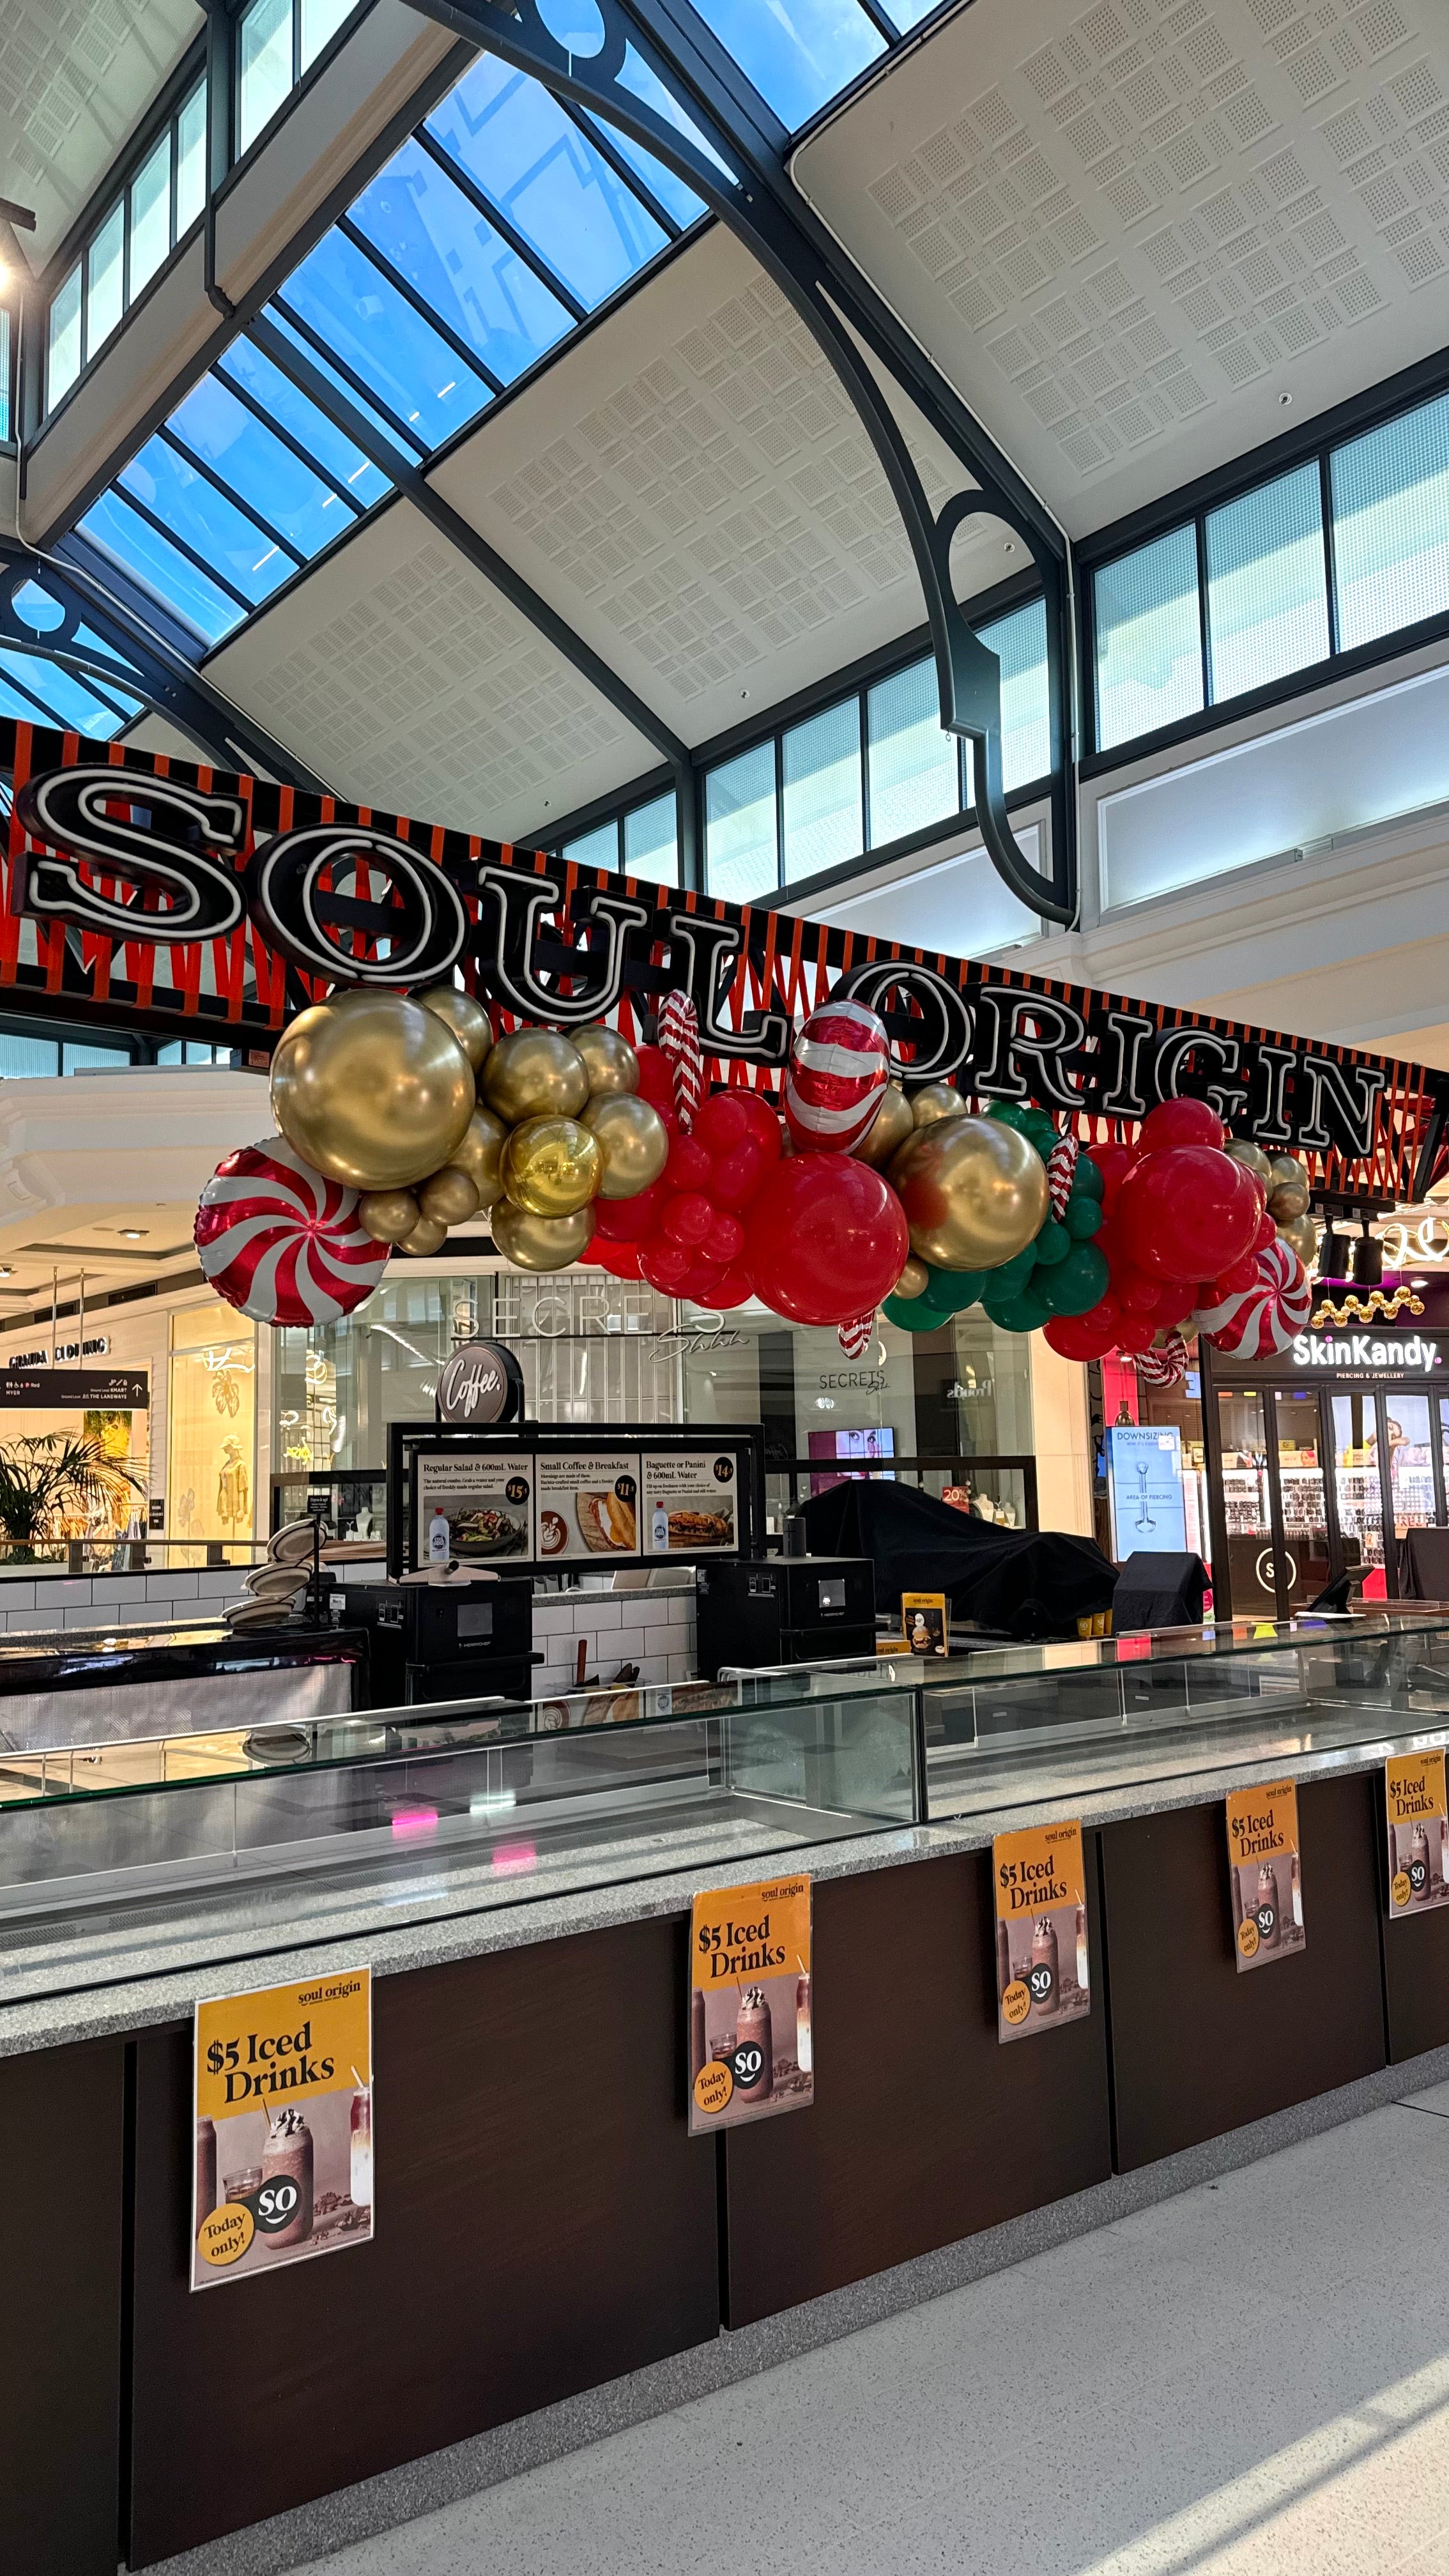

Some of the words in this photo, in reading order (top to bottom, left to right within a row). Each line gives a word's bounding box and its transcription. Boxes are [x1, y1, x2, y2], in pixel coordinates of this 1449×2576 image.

[12, 762, 794, 1068] SOUL
[829, 958, 1388, 1158] ORIGIN
[820, 1370, 884, 1389] SECRETS
[424, 1464, 452, 1474] Regular
[454, 1463, 473, 1471] Salad
[540, 1462, 561, 1470] Small
[646, 1460, 675, 1471] Baguette
[944, 1489, 967, 1501] 20%
[1266, 1788, 1276, 1798] soul
[1276, 1786, 1292, 1797] origin
[1390, 1780, 1401, 1799] $5
[1404, 1775, 1425, 1795] Iced
[1396, 1794, 1434, 1816] Drinks
[1045, 1831, 1057, 1842] soul
[1058, 1827, 1077, 1840] origin
[1232, 1817, 1245, 1839] $5
[1247, 1809, 1274, 1833] Iced
[1240, 1830, 1284, 1857] Drinks
[1000, 1863, 1017, 1889] $5
[1020, 1855, 1055, 1883] Iced
[1411, 1866, 1425, 1881] SO
[762, 1887, 778, 1900] soul
[779, 1883, 804, 1899] origin
[1010, 1879, 1067, 1910] Drinks
[1259, 1910, 1273, 1928] SO
[699, 1924, 721, 1954] $5
[726, 1915, 770, 1947] Iced
[1241, 1926, 1255, 1940] Today
[1243, 1937, 1257, 1952] only!
[710, 1942, 785, 1978] Drinks
[1031, 1971, 1051, 1991] SO
[298, 1987, 322, 2004] soul
[325, 1981, 360, 1998] origin
[1005, 1988, 1025, 2006] Today
[1009, 2001, 1027, 2019] only!
[207, 2038, 240, 2075] $5
[247, 2021, 312, 2064] Iced
[735, 2050, 762, 2074] SO
[225, 2055, 334, 2104] Drinks
[698, 2069, 726, 2090] Today
[703, 2086, 727, 2106] only!
[259, 2186, 297, 2216] SO
[204, 2214, 245, 2239] Today
[211, 2231, 245, 2257] only!
